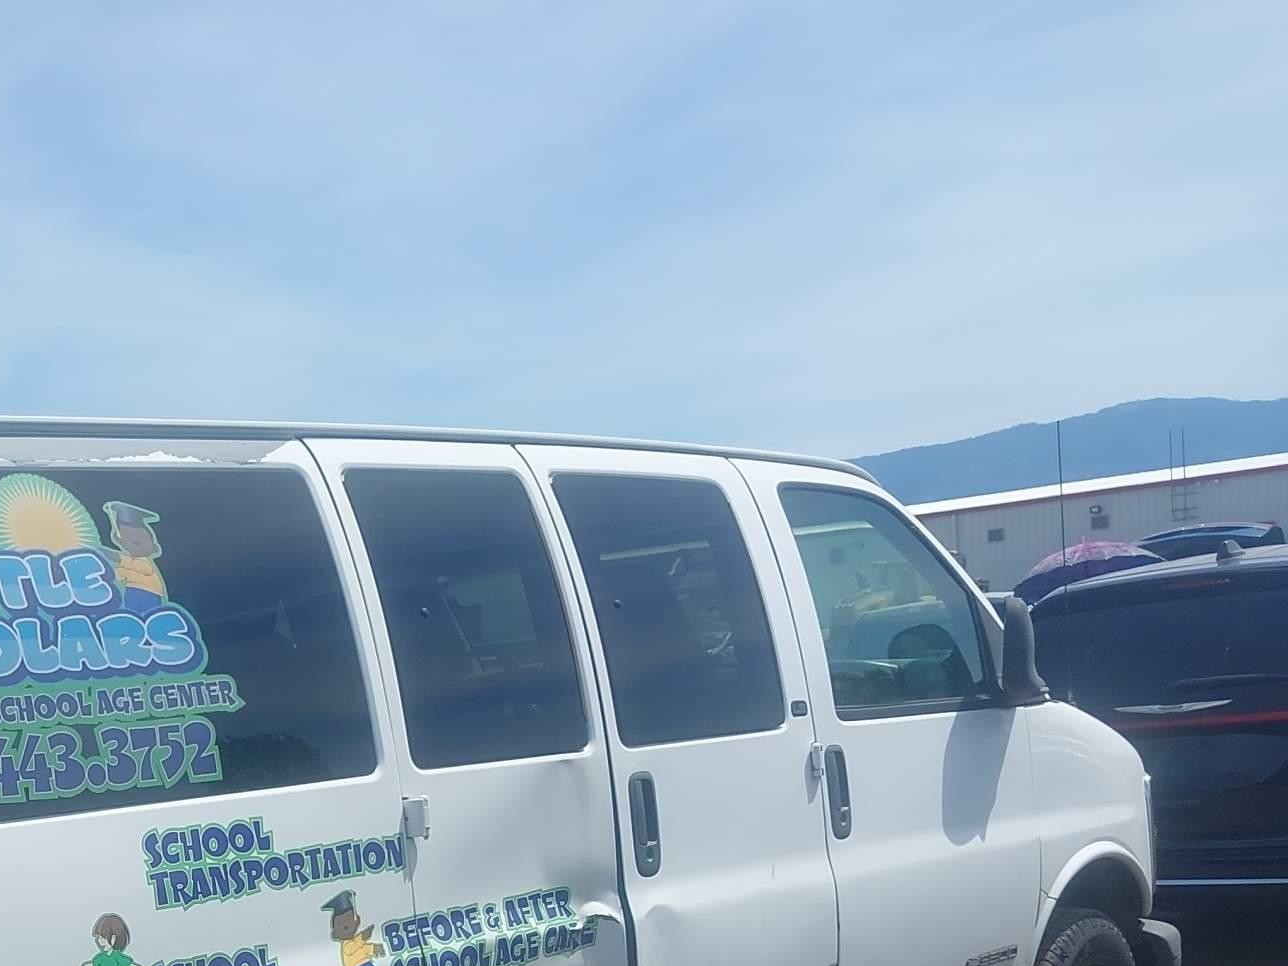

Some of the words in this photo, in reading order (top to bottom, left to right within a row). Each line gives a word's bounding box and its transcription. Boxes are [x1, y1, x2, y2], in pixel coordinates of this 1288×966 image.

[96, 685, 144, 716] AGE
[149, 680, 237, 710] CENTER
[144, 818, 271, 867] SCHOOL
[149, 836, 404, 908] TRANSPORTATION
[383, 907, 479, 953] BEFORE
[485, 906, 501, 930] &
[503, 888, 574, 928] AFTER
[495, 932, 541, 966] AGE
[543, 920, 597, 957] CARE
